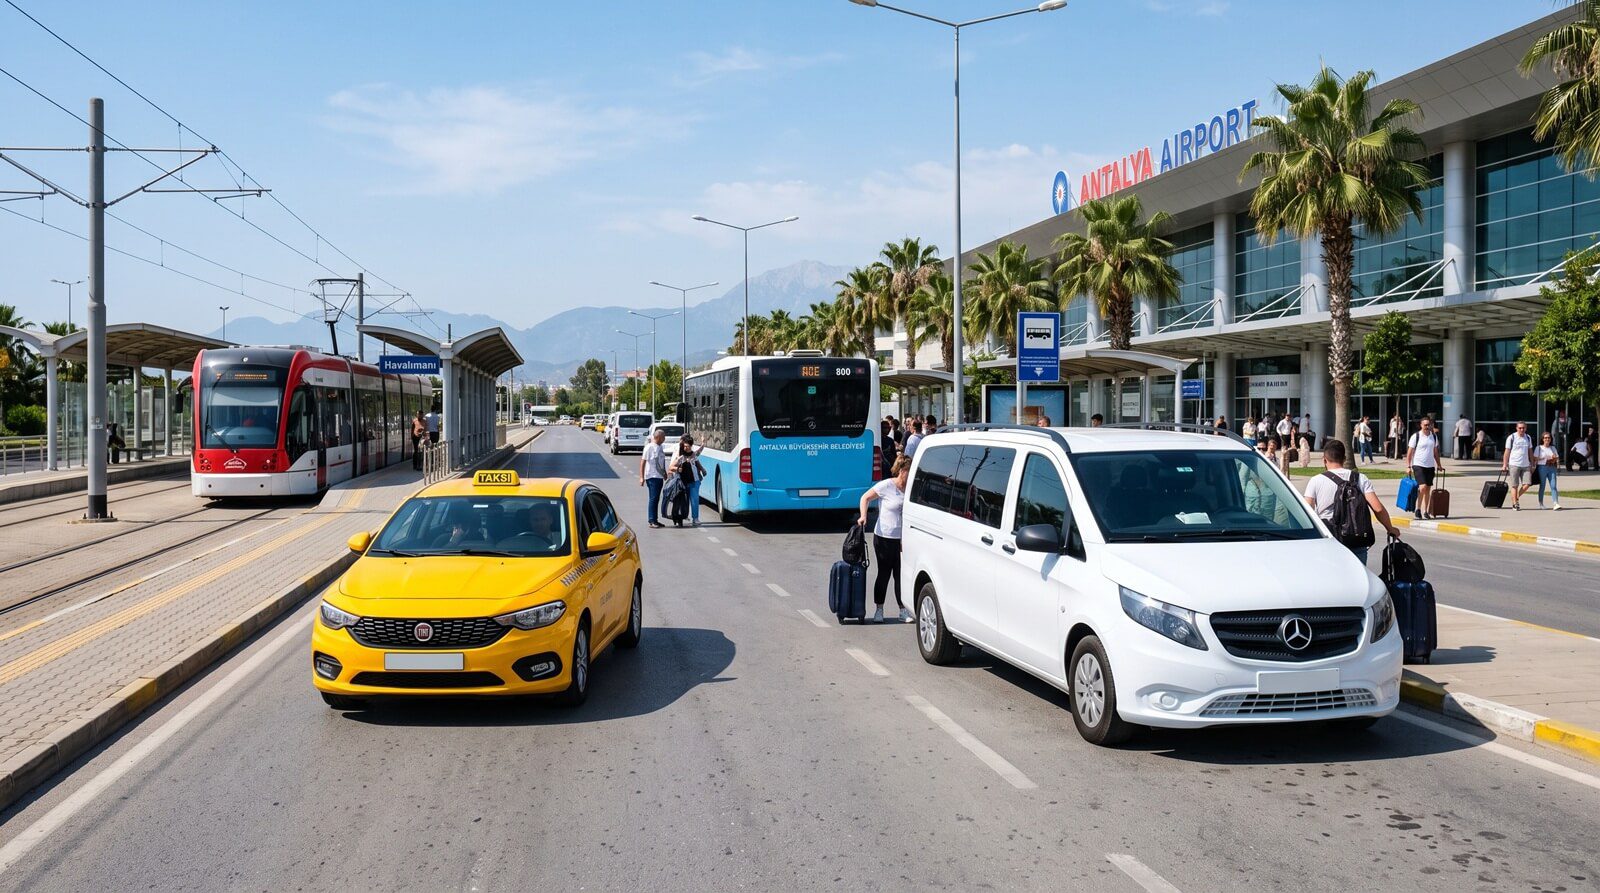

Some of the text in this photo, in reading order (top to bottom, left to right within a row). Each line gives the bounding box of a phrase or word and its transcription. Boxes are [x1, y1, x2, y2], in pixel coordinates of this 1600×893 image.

[1080, 99, 1256, 205] ANTALYA AIRPORT
[836, 367, 851, 376] 800
[479, 473, 511, 482] TAKSI
